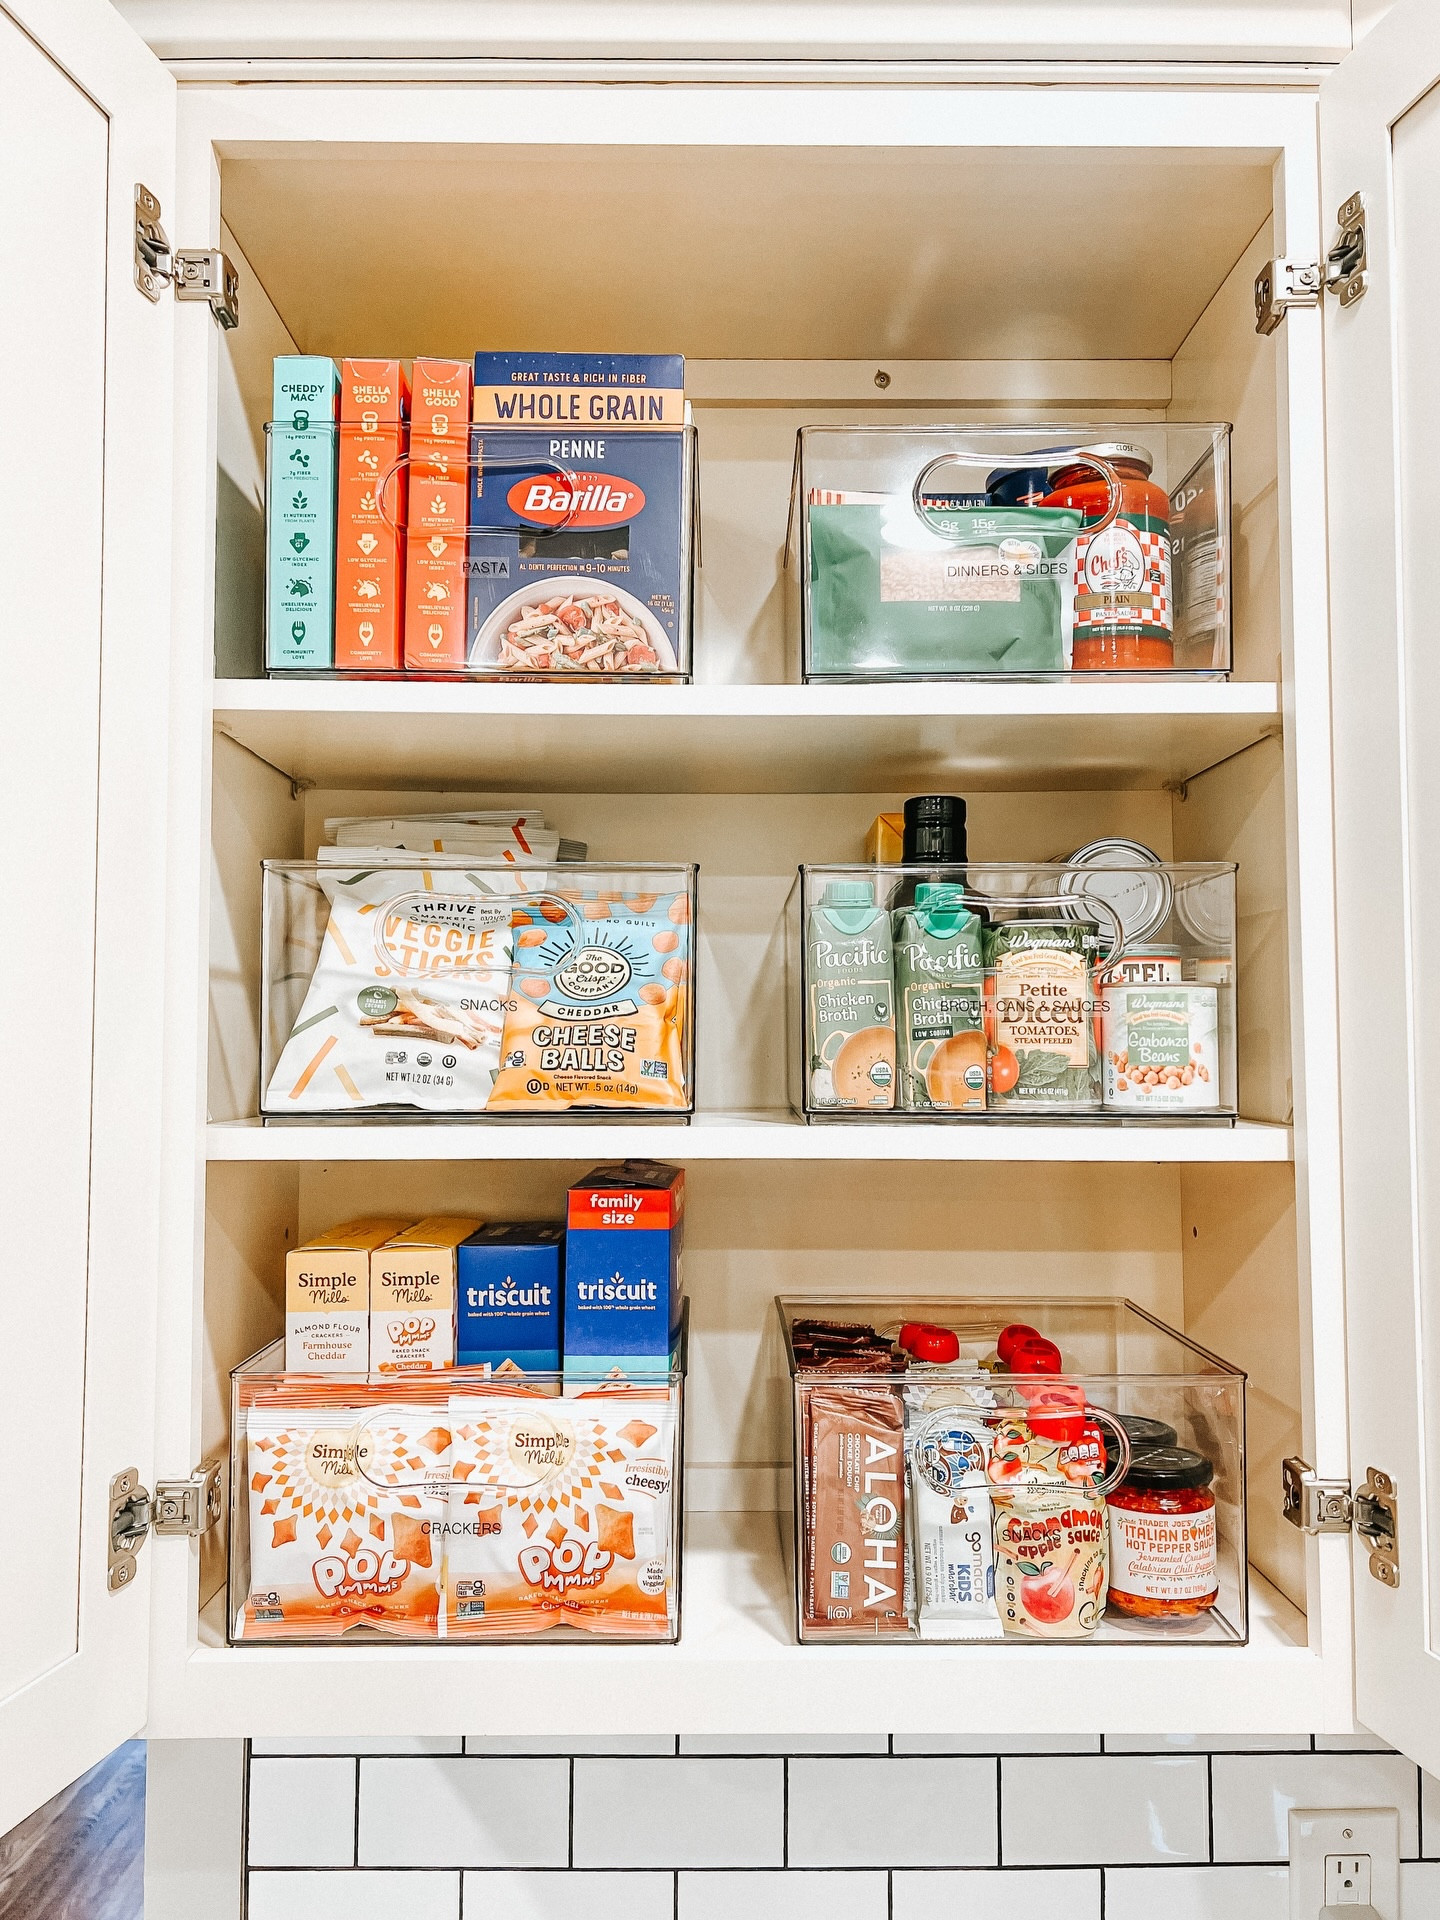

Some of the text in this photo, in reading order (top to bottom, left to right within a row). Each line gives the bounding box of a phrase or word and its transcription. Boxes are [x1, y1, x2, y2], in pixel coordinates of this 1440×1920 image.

[511, 372, 646, 383] GREAT TASTE & RICH IN FIBER
[352, 386, 390, 394] SHELLA
[423, 389, 461, 398] SHELLA
[355, 395, 387, 403] GOOD
[425, 398, 458, 406] GOOD
[494, 393, 663, 420] WHOLE GRAIN
[550, 440, 605, 458] PENNE
[1116, 444, 1133, 452] CLOSE
[524, 485, 628, 512] Barilla
[463, 562, 507, 574] PASTA
[586, 563, 605, 573] 9-10
[948, 563, 1067, 577] DINNERS & SIDES
[412, 903, 476, 914] THRIVE
[385, 915, 495, 952] VEGGIE
[1007, 931, 1075, 950] Wegmans
[810, 940, 889, 968] Pacific
[903, 943, 981, 971] Pacific
[375, 942, 494, 982] STICKS
[564, 962, 624, 974] GOOD
[569, 981, 614, 993] COMPANY
[576, 975, 607, 984] Crisp
[817, 977, 856, 990] Organic
[910, 982, 950, 993] Organic
[1019, 982, 1067, 996] Petite
[461, 999, 517, 1012] SNACKS
[819, 992, 874, 1008] Chicken
[941, 1001, 1110, 1014] BROTH, CANS & SAUCES
[1131, 995, 1185, 1011] Wegmans
[558, 1005, 619, 1016] CHEDDAR
[820, 1007, 857, 1023] Broth
[1001, 996, 1083, 1023] Diced
[913, 1011, 952, 1025] Broth
[532, 1024, 637, 1052] CHEESE
[1009, 1026, 1077, 1036] TOMATOES
[1128, 1031, 1188, 1048] Garbanzo
[541, 1048, 625, 1072] BALLS
[1137, 1048, 1180, 1063] Beans
[386, 1072, 431, 1084] NET WT 1.2 OZ
[556, 1083, 573, 1091] NET
[575, 1083, 590, 1091] WT.
[593, 1083, 601, 1091] .5
[616, 1084, 638, 1094] (14g)
[590, 1194, 643, 1211] family
[602, 1210, 634, 1224] size
[298, 1273, 357, 1290] Simple
[382, 1271, 440, 1288] Simple
[309, 1289, 348, 1304] Mills
[392, 1288, 430, 1303] Mills
[467, 1283, 550, 1307] triscuit
[578, 1278, 657, 1300] triscuit
[294, 1323, 361, 1335] ALMOND FLOUR
[387, 1317, 435, 1344] POP
[303, 1342, 352, 1350] Farmhouse
[308, 1352, 346, 1360] Cheddar
[396, 1362, 427, 1370] Cheddar
[625, 1464, 671, 1479] Irresistibly
[626, 1475, 670, 1493] cheesy!
[421, 1522, 501, 1535] CRACKERS
[863, 1434, 898, 1608] ALOHA
[1008, 1509, 1102, 1543] Cinnamon
[1139, 1518, 1169, 1527] TRADER
[1002, 1529, 1061, 1541] SNACKS
[1126, 1525, 1178, 1541] ITALIAN
[1018, 1529, 1100, 1560] apple sauce
[1126, 1536, 1214, 1553] HOT PEPPER SAUCE
[518, 1539, 612, 1586] POP
[1136, 1552, 1183, 1563] Fermented
[313, 1549, 411, 1597] POP
[965, 1532, 983, 1602] gomacro
[1128, 1561, 1192, 1574] Calabrian Chili
[926, 1578, 931, 1586] OZ
[948, 1564, 958, 1601] macrobar
